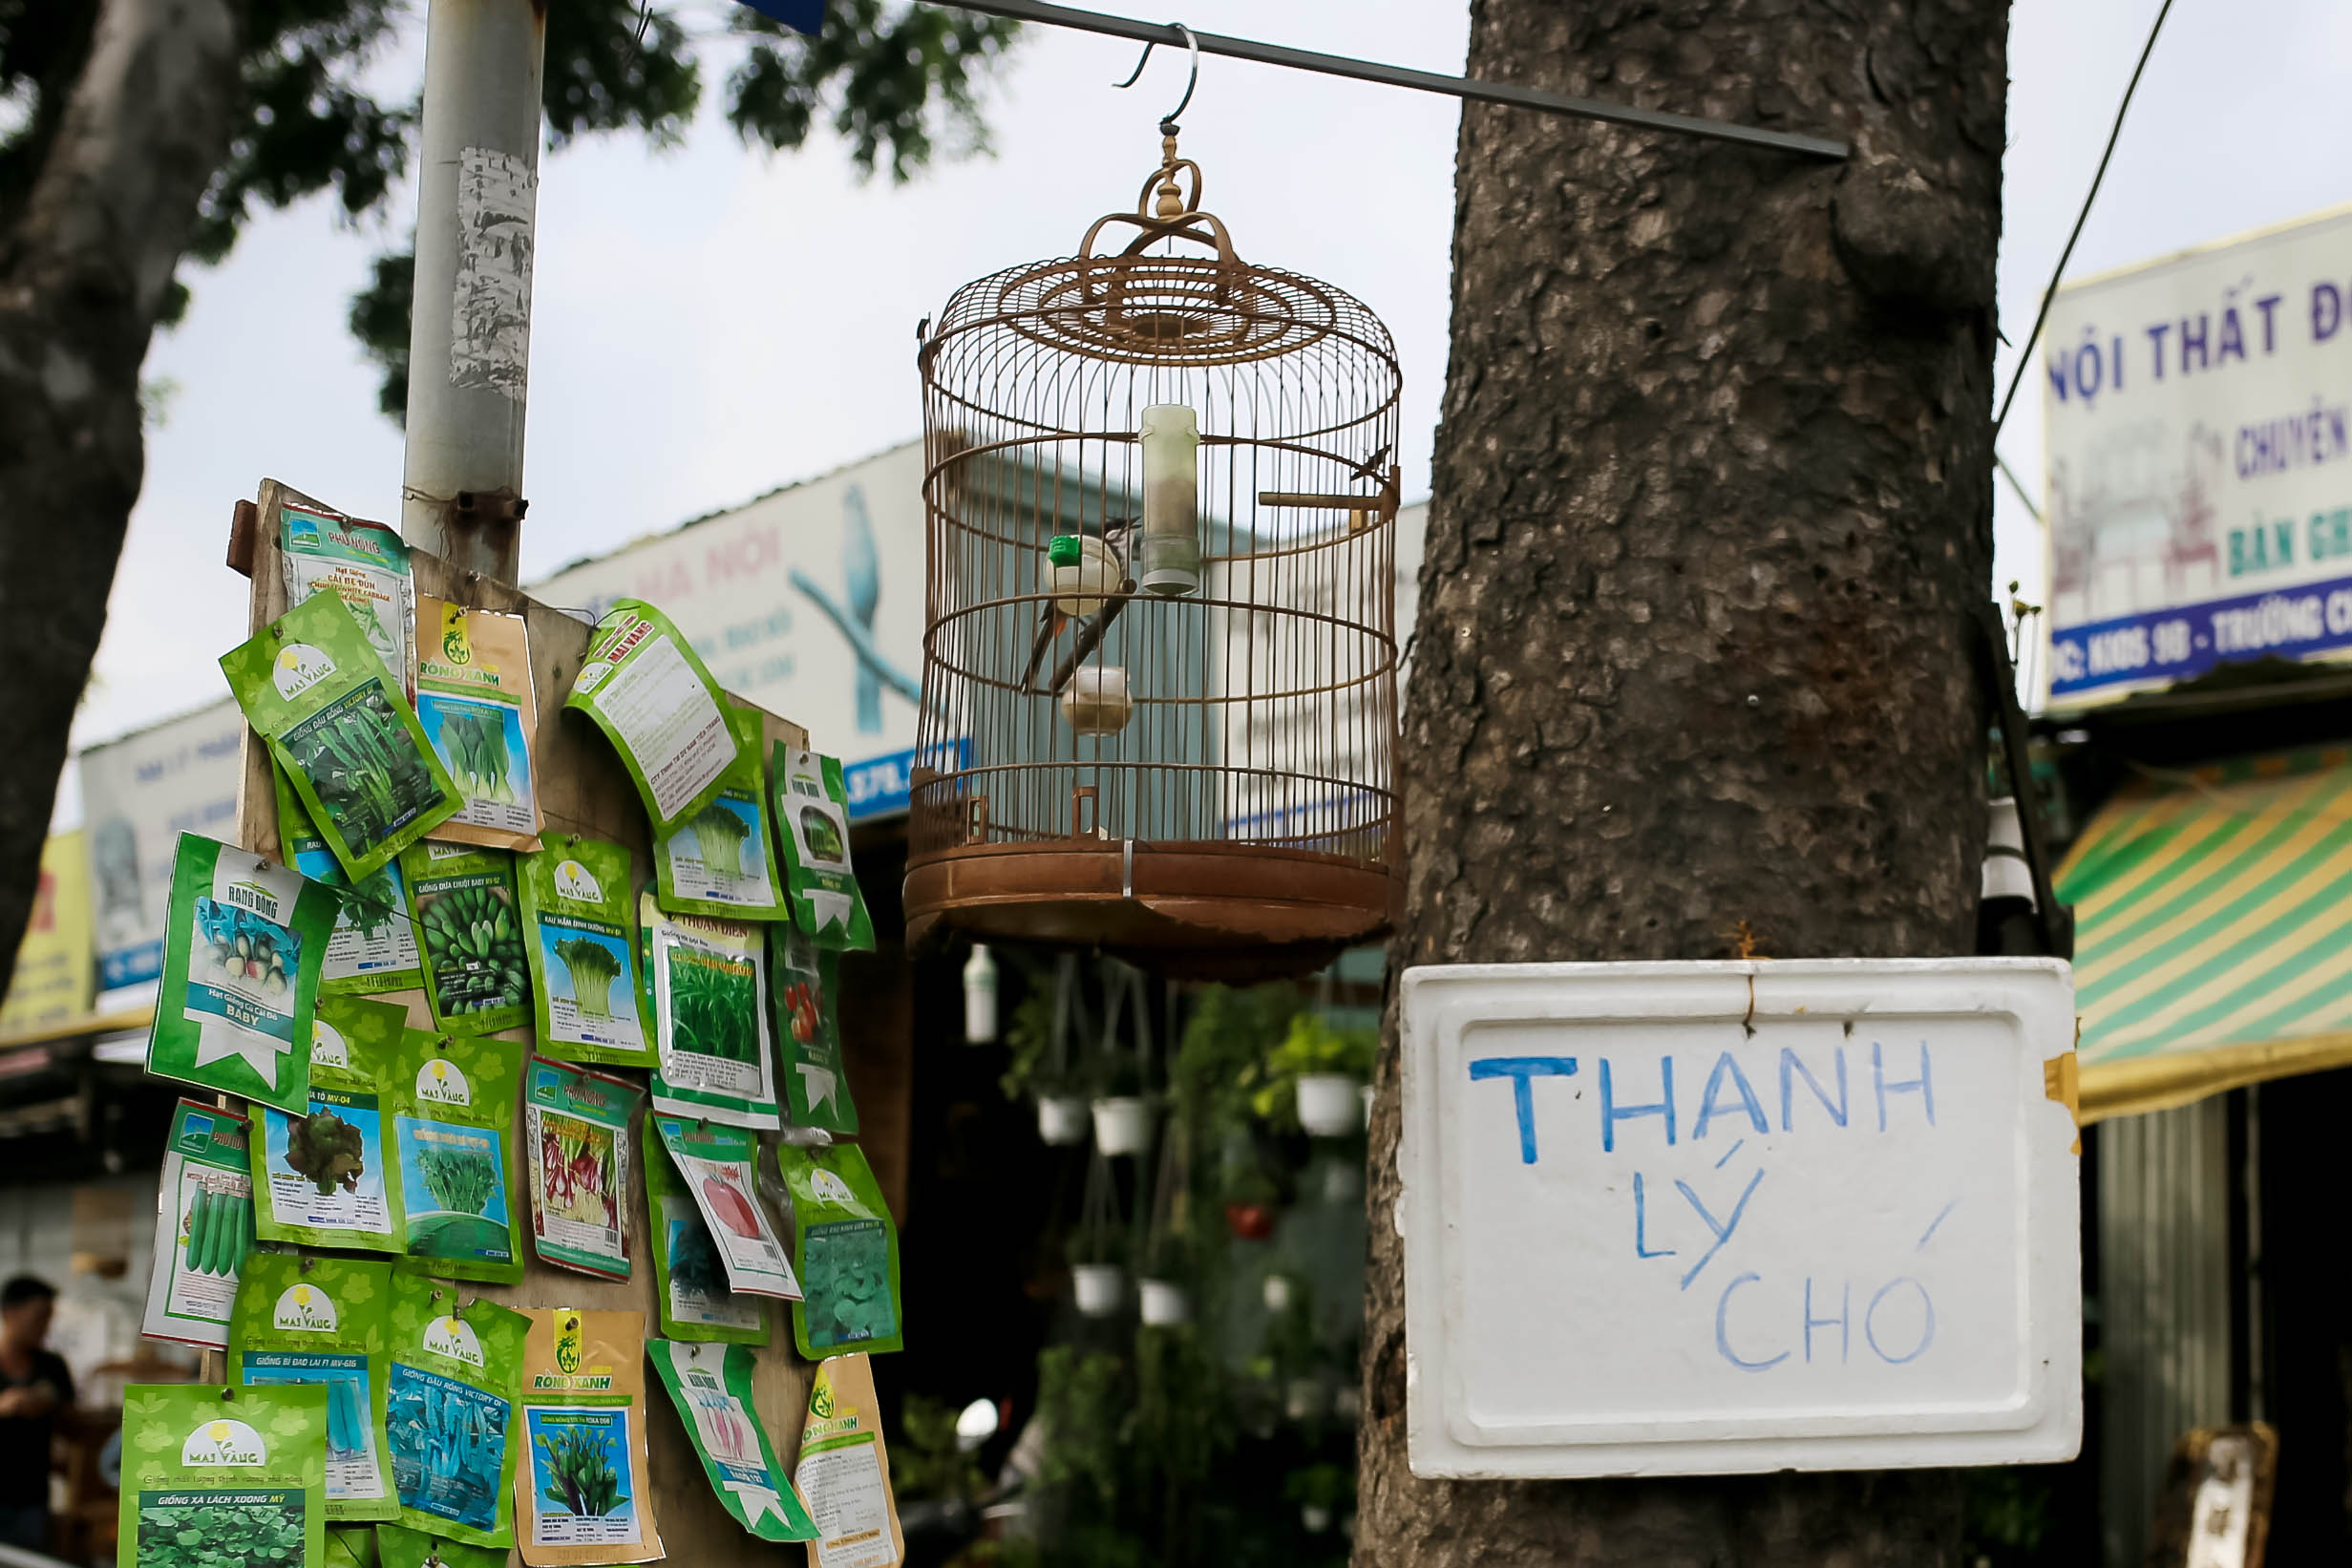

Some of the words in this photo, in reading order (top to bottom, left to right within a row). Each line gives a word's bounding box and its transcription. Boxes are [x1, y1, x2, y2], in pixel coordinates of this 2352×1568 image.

[2146, 277, 2281, 379] THẤT
[293, 722, 313, 742] GIỐNG
[208, 987, 223, 1000] Hạt
[225, 1006, 260, 1028] BABY
[1469, 1040, 1936, 1164] THANH
[1634, 1139, 1765, 1290] LÝ
[1715, 1198, 1961, 1372] CHÓ
[256, 1355, 281, 1366] GIỐNG
[533, 1369, 570, 1389] RỒNG
[573, 1376, 611, 1389] XANH
[189, 1452, 215, 1463] MAI
[220, 1450, 258, 1463] VÀNG
[158, 1494, 189, 1505] GIỐNG
[234, 1494, 267, 1504] XOONG
